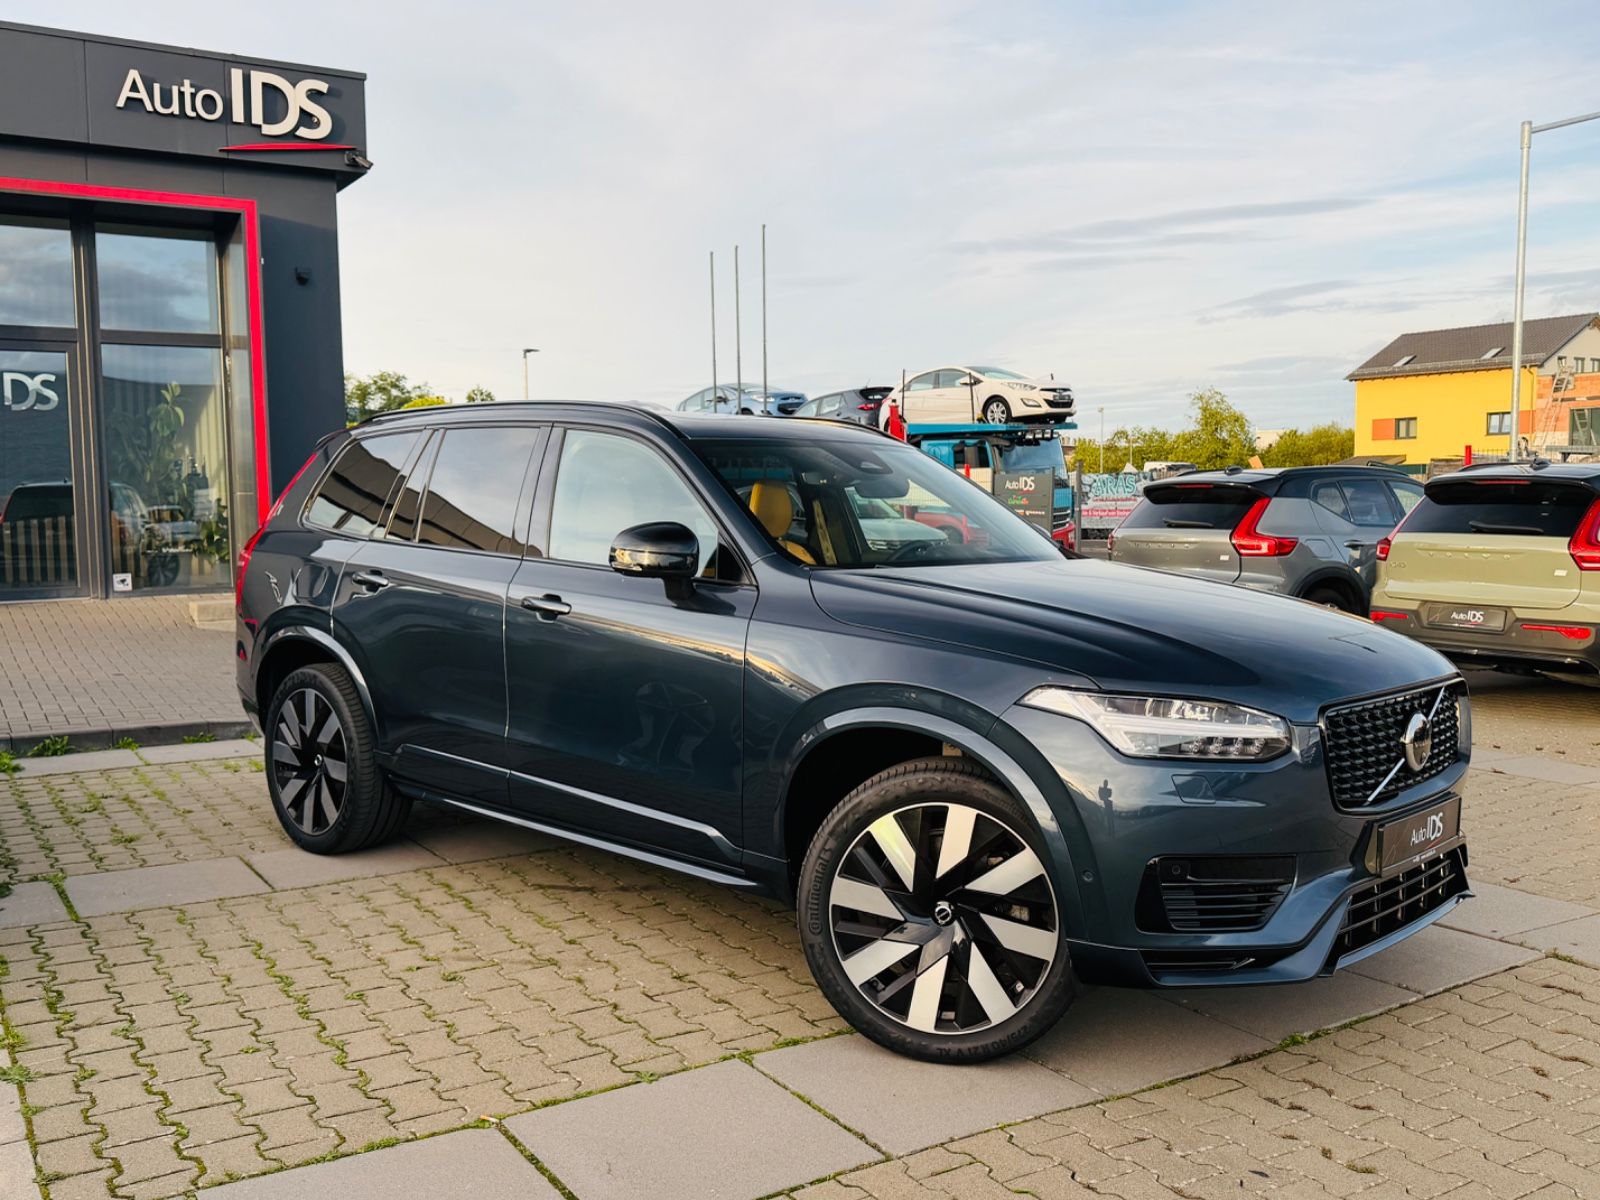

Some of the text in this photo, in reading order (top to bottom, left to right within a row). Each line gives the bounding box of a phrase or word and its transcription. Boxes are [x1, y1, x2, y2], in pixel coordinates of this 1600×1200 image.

[116, 68, 332, 140] Auto IDS
[1004, 476, 1035, 490] Auto IDS
[1451, 610, 1484, 622] Auto IDS
[1410, 812, 1443, 846] Auto IDS
[808, 854, 830, 936] Continental
